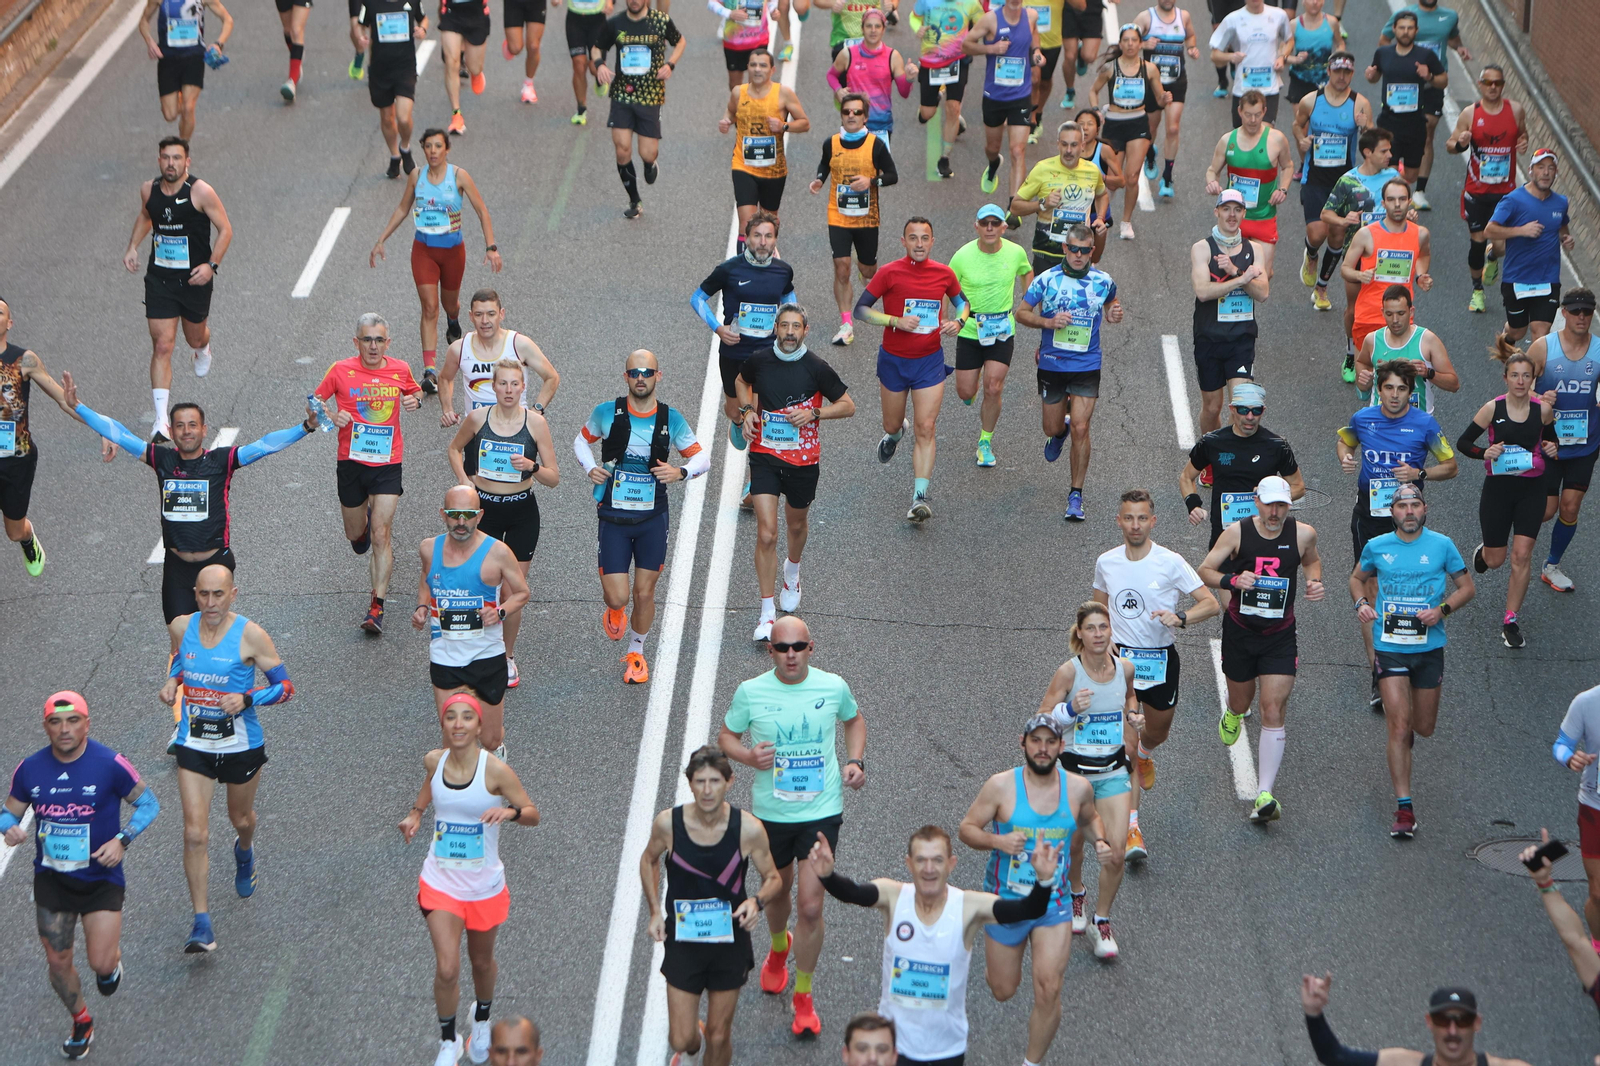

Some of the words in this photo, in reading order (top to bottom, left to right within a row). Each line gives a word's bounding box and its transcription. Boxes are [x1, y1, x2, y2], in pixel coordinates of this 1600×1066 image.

[1557, 379, 1592, 394] ADS
[350, 386, 400, 398] MADRID
[371, 400, 382, 408] 42
[367, 428, 389, 436] ZURICH
[361, 447, 376, 455] JAVIER
[494, 445, 518, 453] ZURICH
[628, 475, 651, 483] ZURICH
[478, 492, 501, 503] NIKE
[502, 492, 528, 503] PRO
[1258, 578, 1283, 587] ZURICH
[432, 588, 469, 597] enerplus
[1382, 583, 1435, 598] VALENCIA
[1256, 592, 1271, 600] 2321
[1398, 605, 1423, 613] ZURICH
[451, 614, 467, 622] 3017
[1137, 652, 1161, 660] ZURICH
[1132, 673, 1155, 681] LEMENTE
[202, 709, 227, 717] ZURICH
[1093, 714, 1118, 723] ZURICH
[1091, 728, 1107, 736] 6140
[792, 758, 820, 768] ZURICH
[792, 774, 809, 783] 6529
[53, 827, 82, 836] ZURICH
[450, 825, 478, 834] ZURICH
[693, 901, 723, 911] ZURICH
[694, 919, 713, 928] 6340
[912, 963, 944, 974] ZURICH
